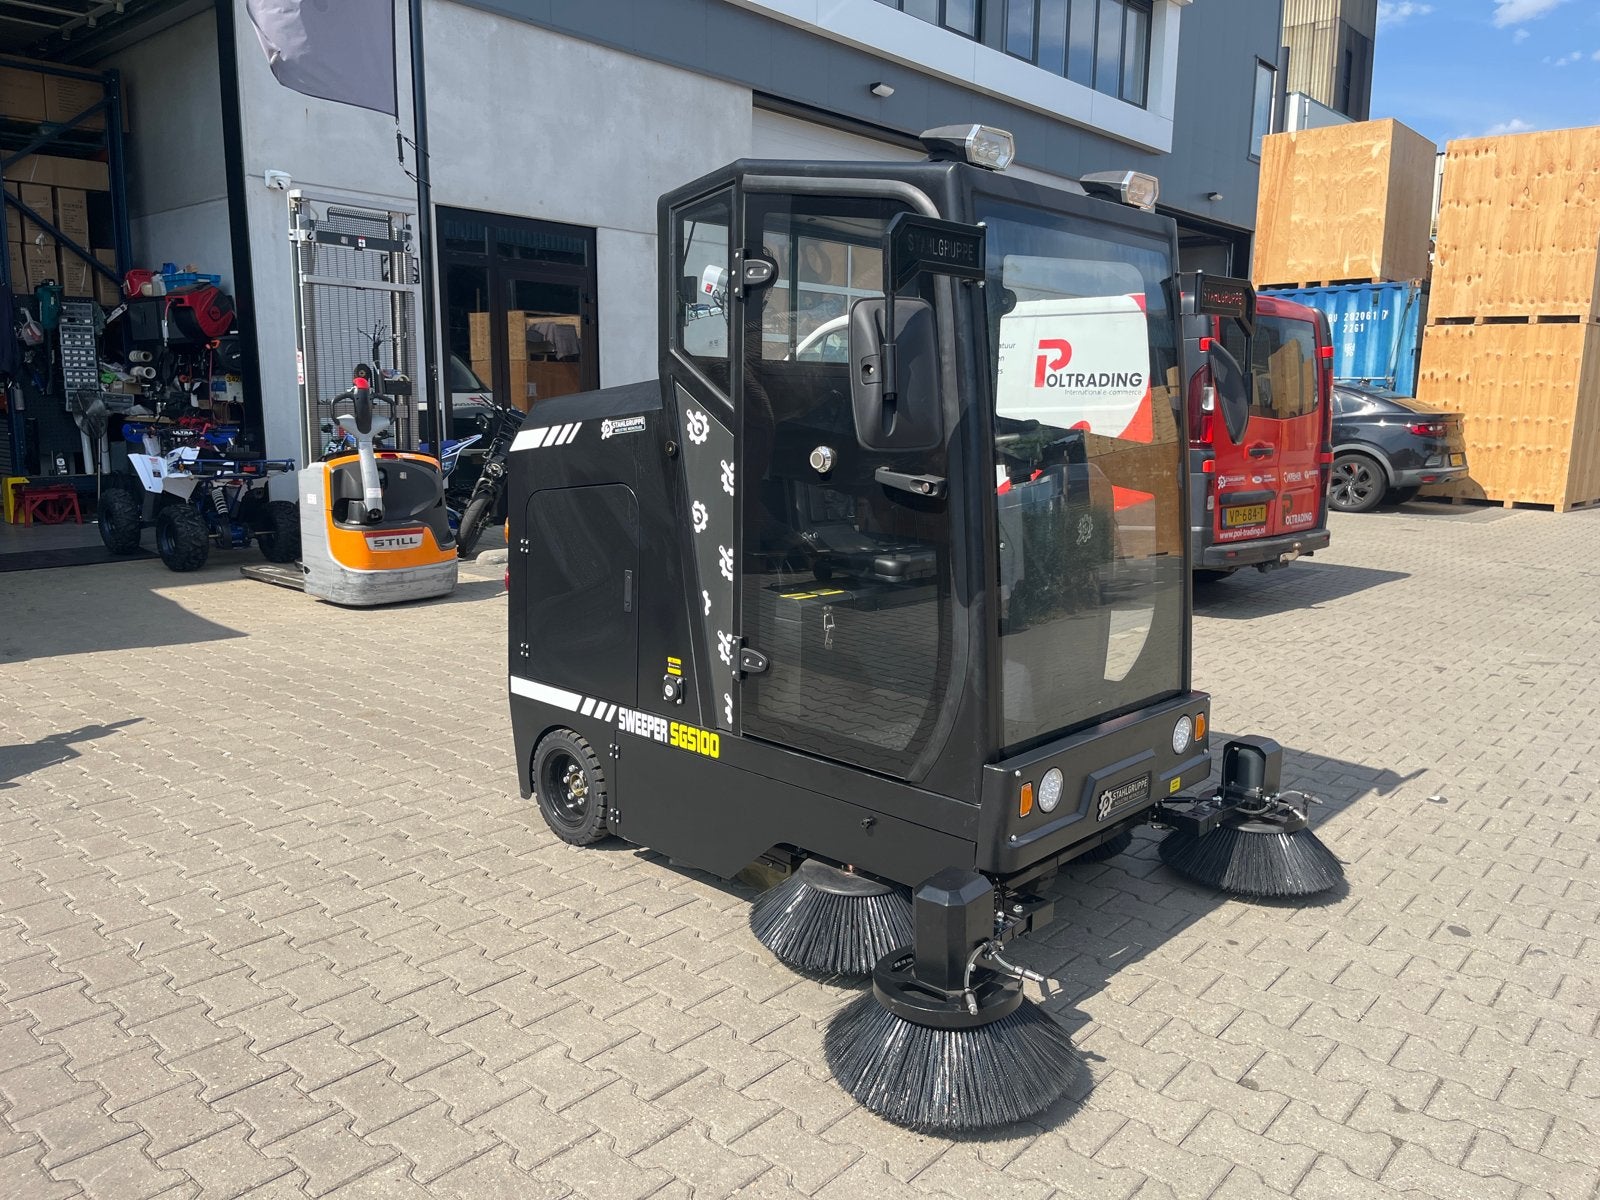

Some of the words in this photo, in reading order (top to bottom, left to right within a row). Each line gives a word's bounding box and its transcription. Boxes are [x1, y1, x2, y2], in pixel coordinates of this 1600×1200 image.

[1229, 507, 1265, 523] VP-684-T
[1219, 526, 1266, 540] www.pol-trading.nl
[374, 537, 418, 548] STILL
[618, 706, 668, 743] SWEEPER
[1112, 778, 1148, 801] STAHLGRUPPE
